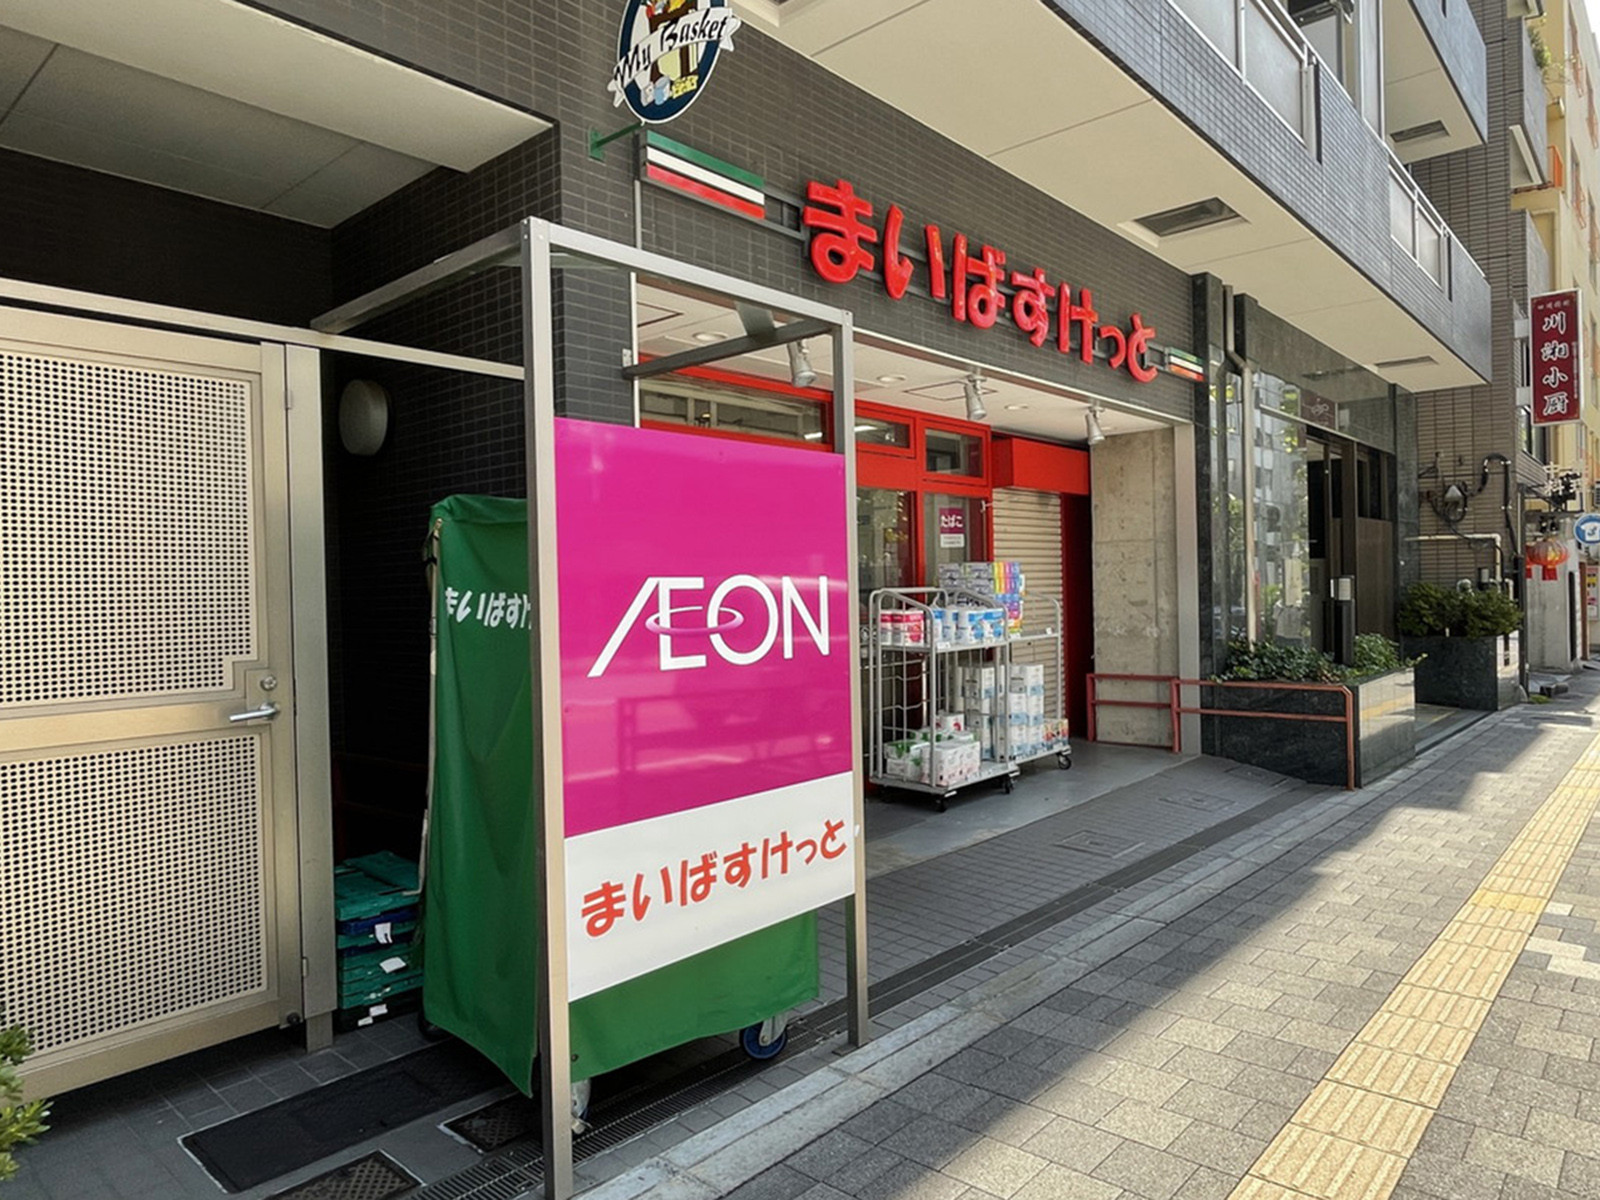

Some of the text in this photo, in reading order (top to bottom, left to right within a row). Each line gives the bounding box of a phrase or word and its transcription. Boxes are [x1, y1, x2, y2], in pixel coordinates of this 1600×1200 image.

[613, 7, 727, 86] My Basket
[803, 179, 1158, 383] まいばすけっと
[581, 819, 847, 938] まいばすけっと
